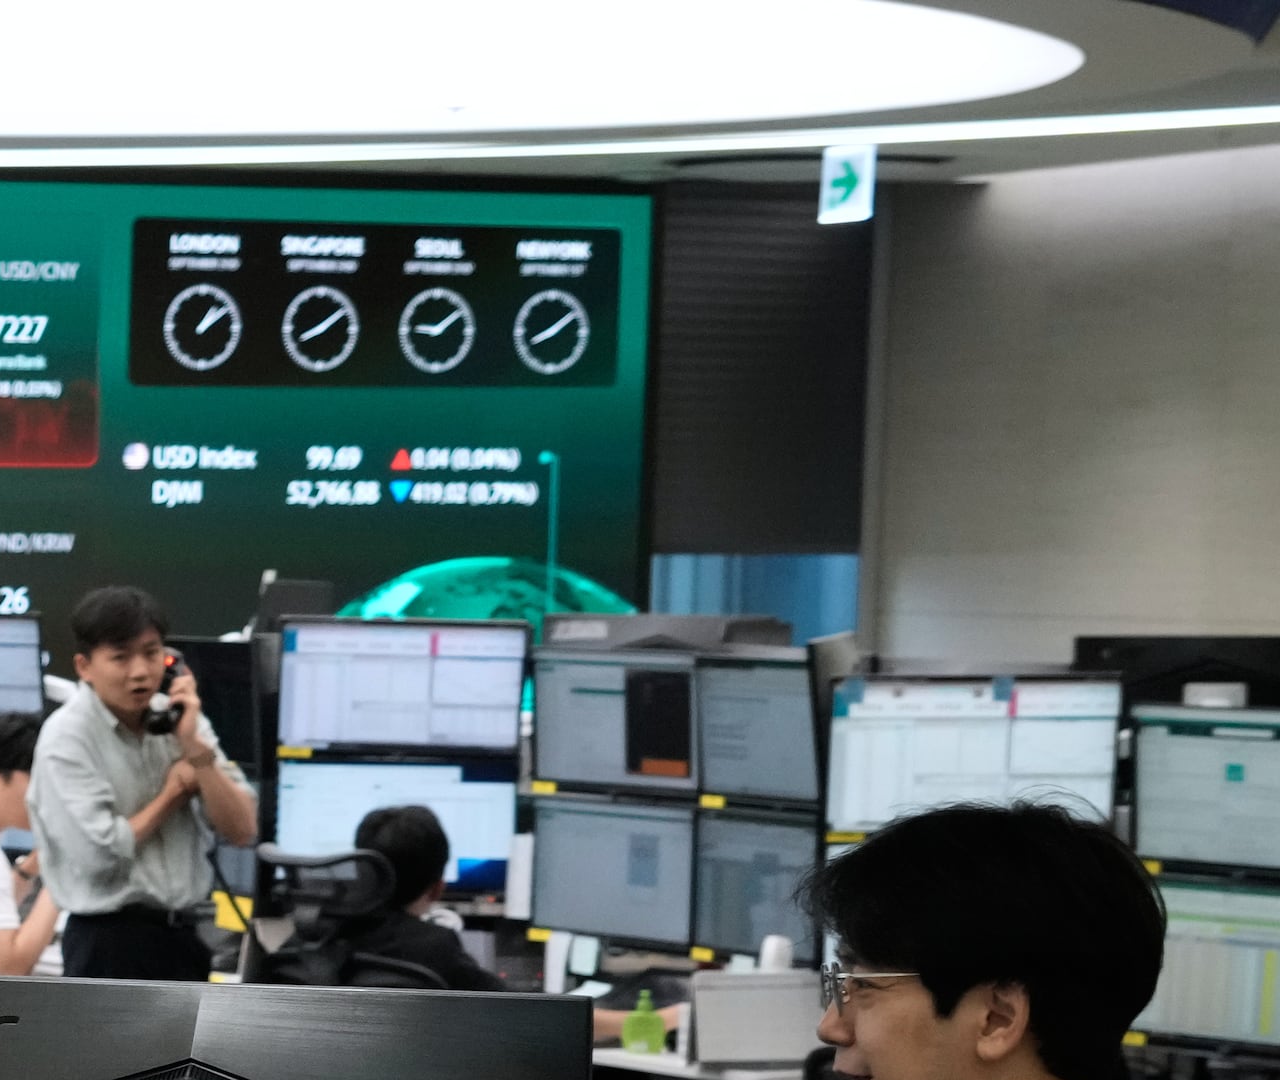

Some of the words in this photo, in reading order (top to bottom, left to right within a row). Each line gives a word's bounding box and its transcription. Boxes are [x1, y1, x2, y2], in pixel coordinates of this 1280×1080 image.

[169, 233, 240, 254] LONDON
[281, 235, 365, 258] SINGAPORE
[414, 237, 464, 259] SEOUL
[152, 445, 198, 470] USD
[198, 444, 258, 470] Index
[306, 445, 363, 471] 99.69
